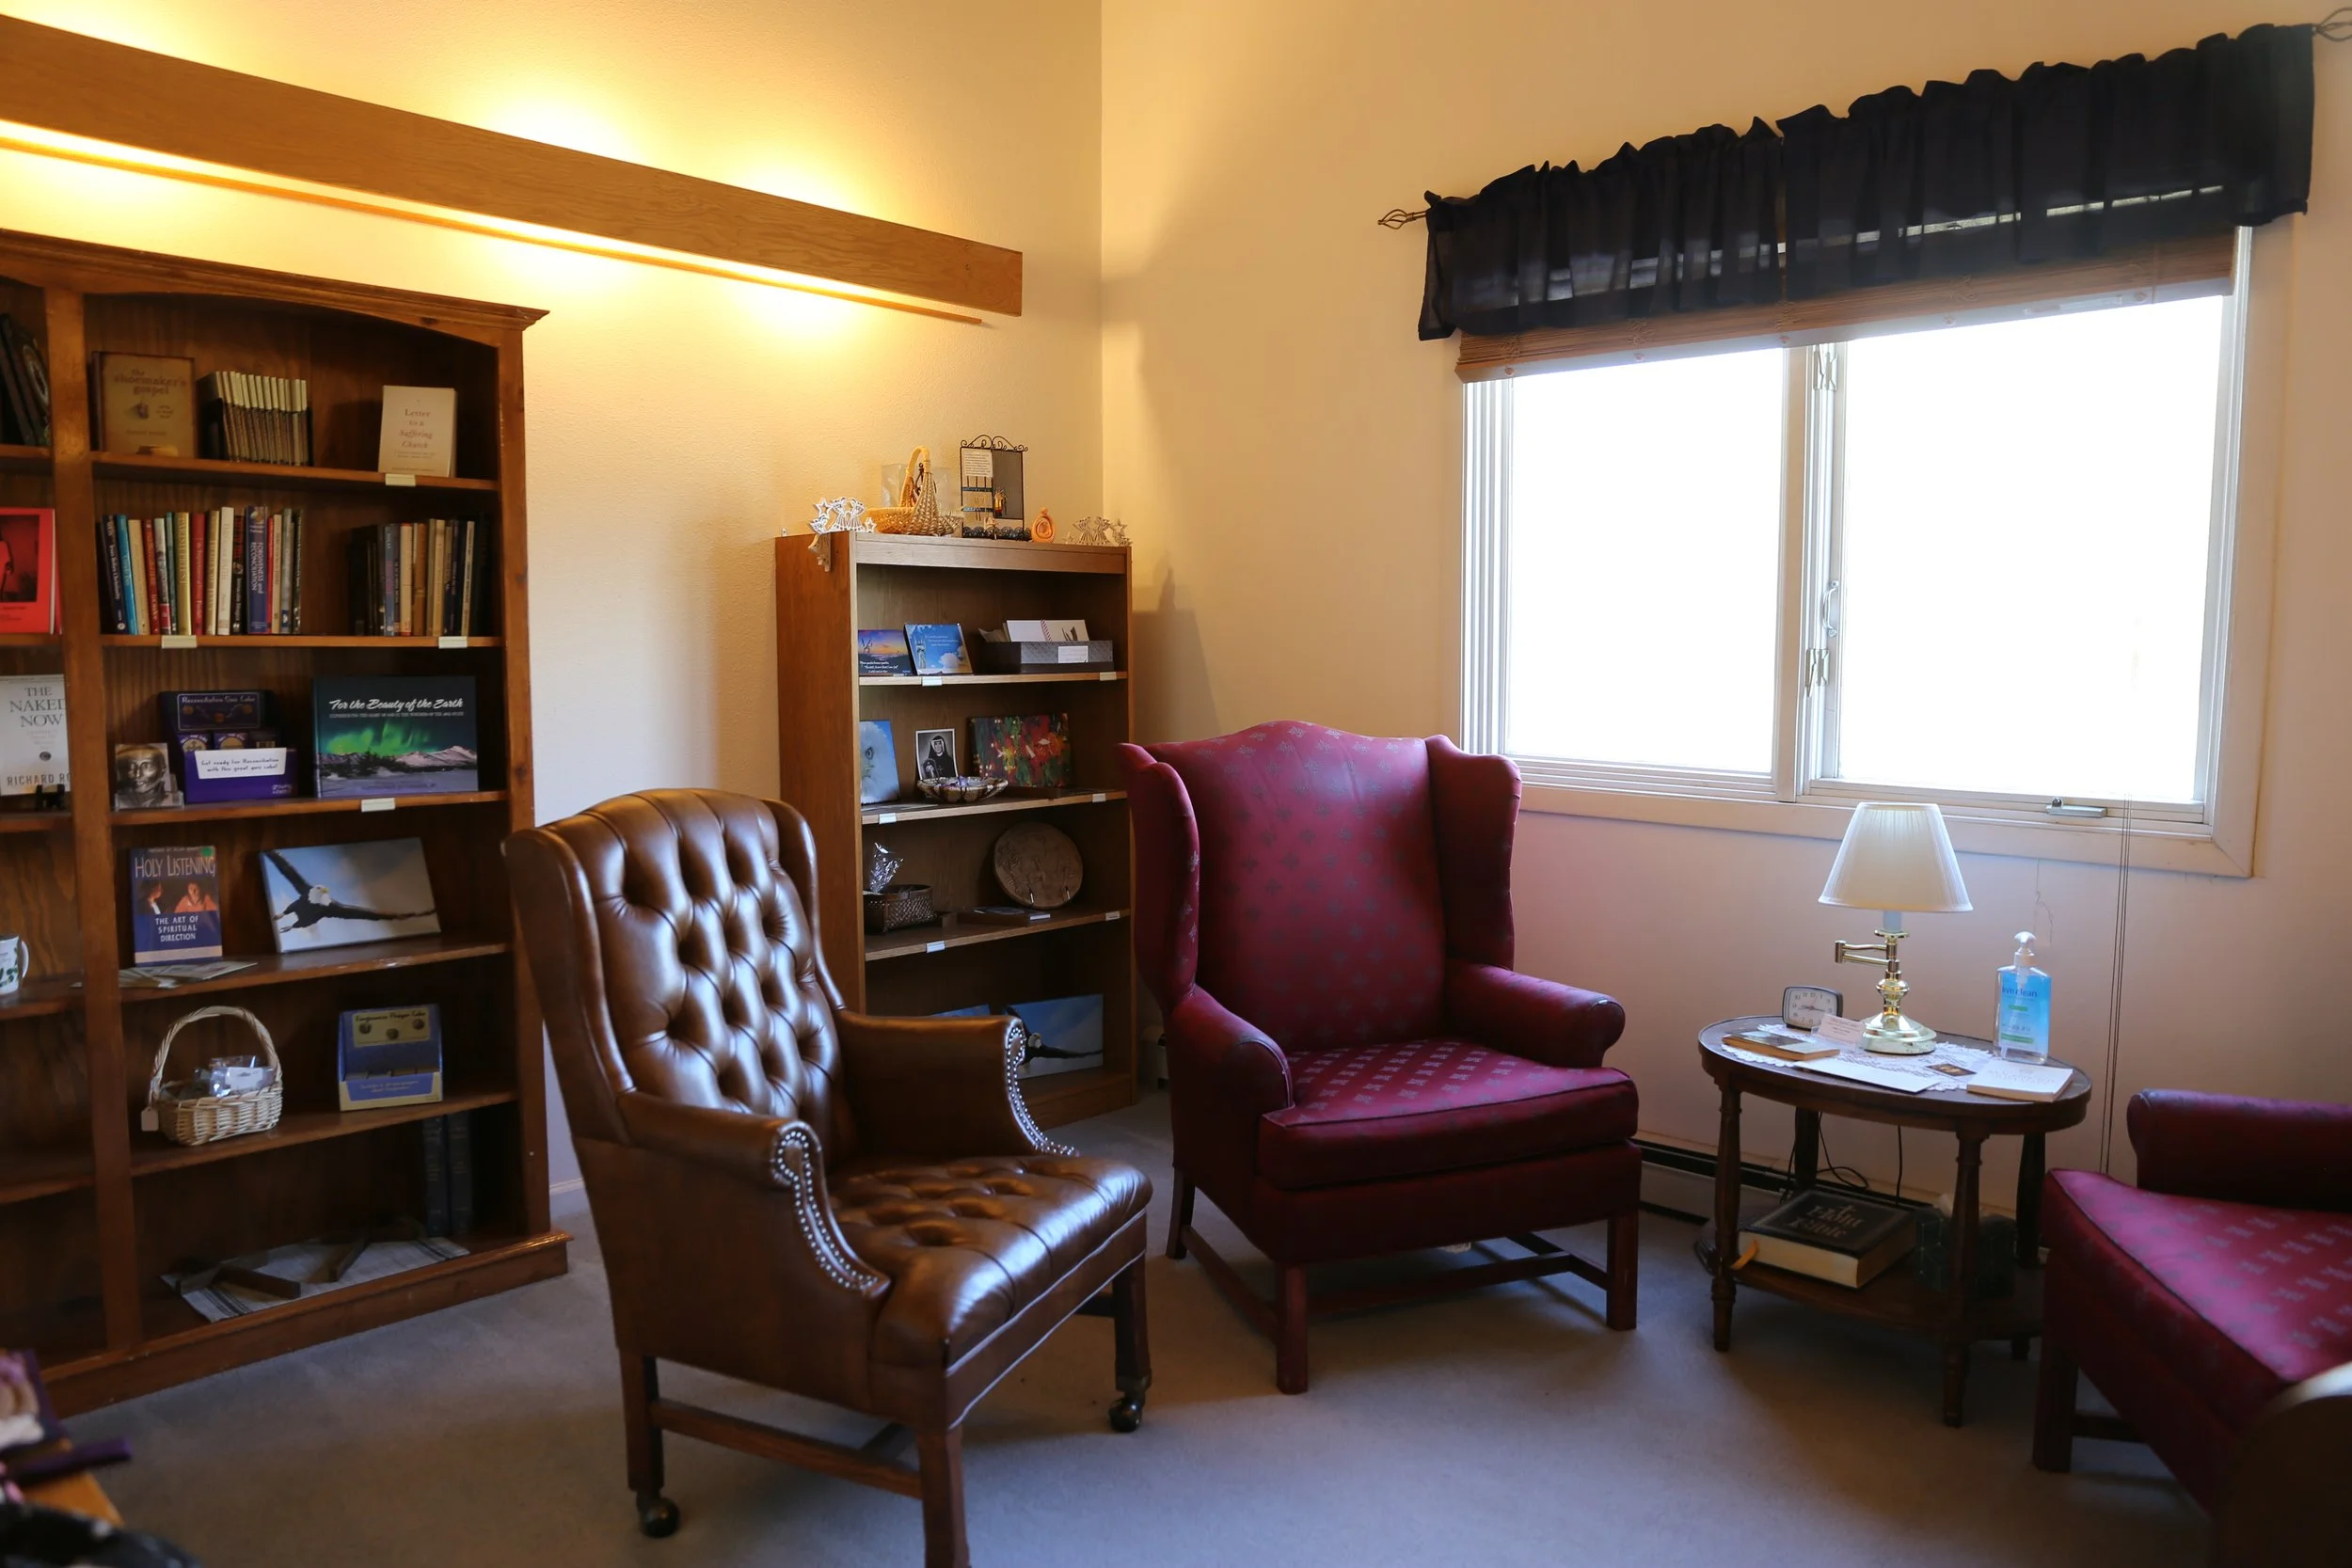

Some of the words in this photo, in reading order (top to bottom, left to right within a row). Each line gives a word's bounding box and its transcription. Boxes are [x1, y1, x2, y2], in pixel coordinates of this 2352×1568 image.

[114, 373, 187, 387] shoemaker's
[26, 687, 53, 697] THE
[328, 699, 348, 710] For
[349, 699, 366, 709] the
[366, 699, 405, 713] Beauty
[405, 698, 418, 712] of
[416, 698, 433, 709] the
[433, 698, 464, 709] Earth
[21, 714, 62, 728] NOW
[7, 773, 55, 786] RICHARD
[189, 914, 199, 923] OF
[158, 925, 198, 934] SPIRITUAL
[160, 933, 196, 942] DIRECTION
